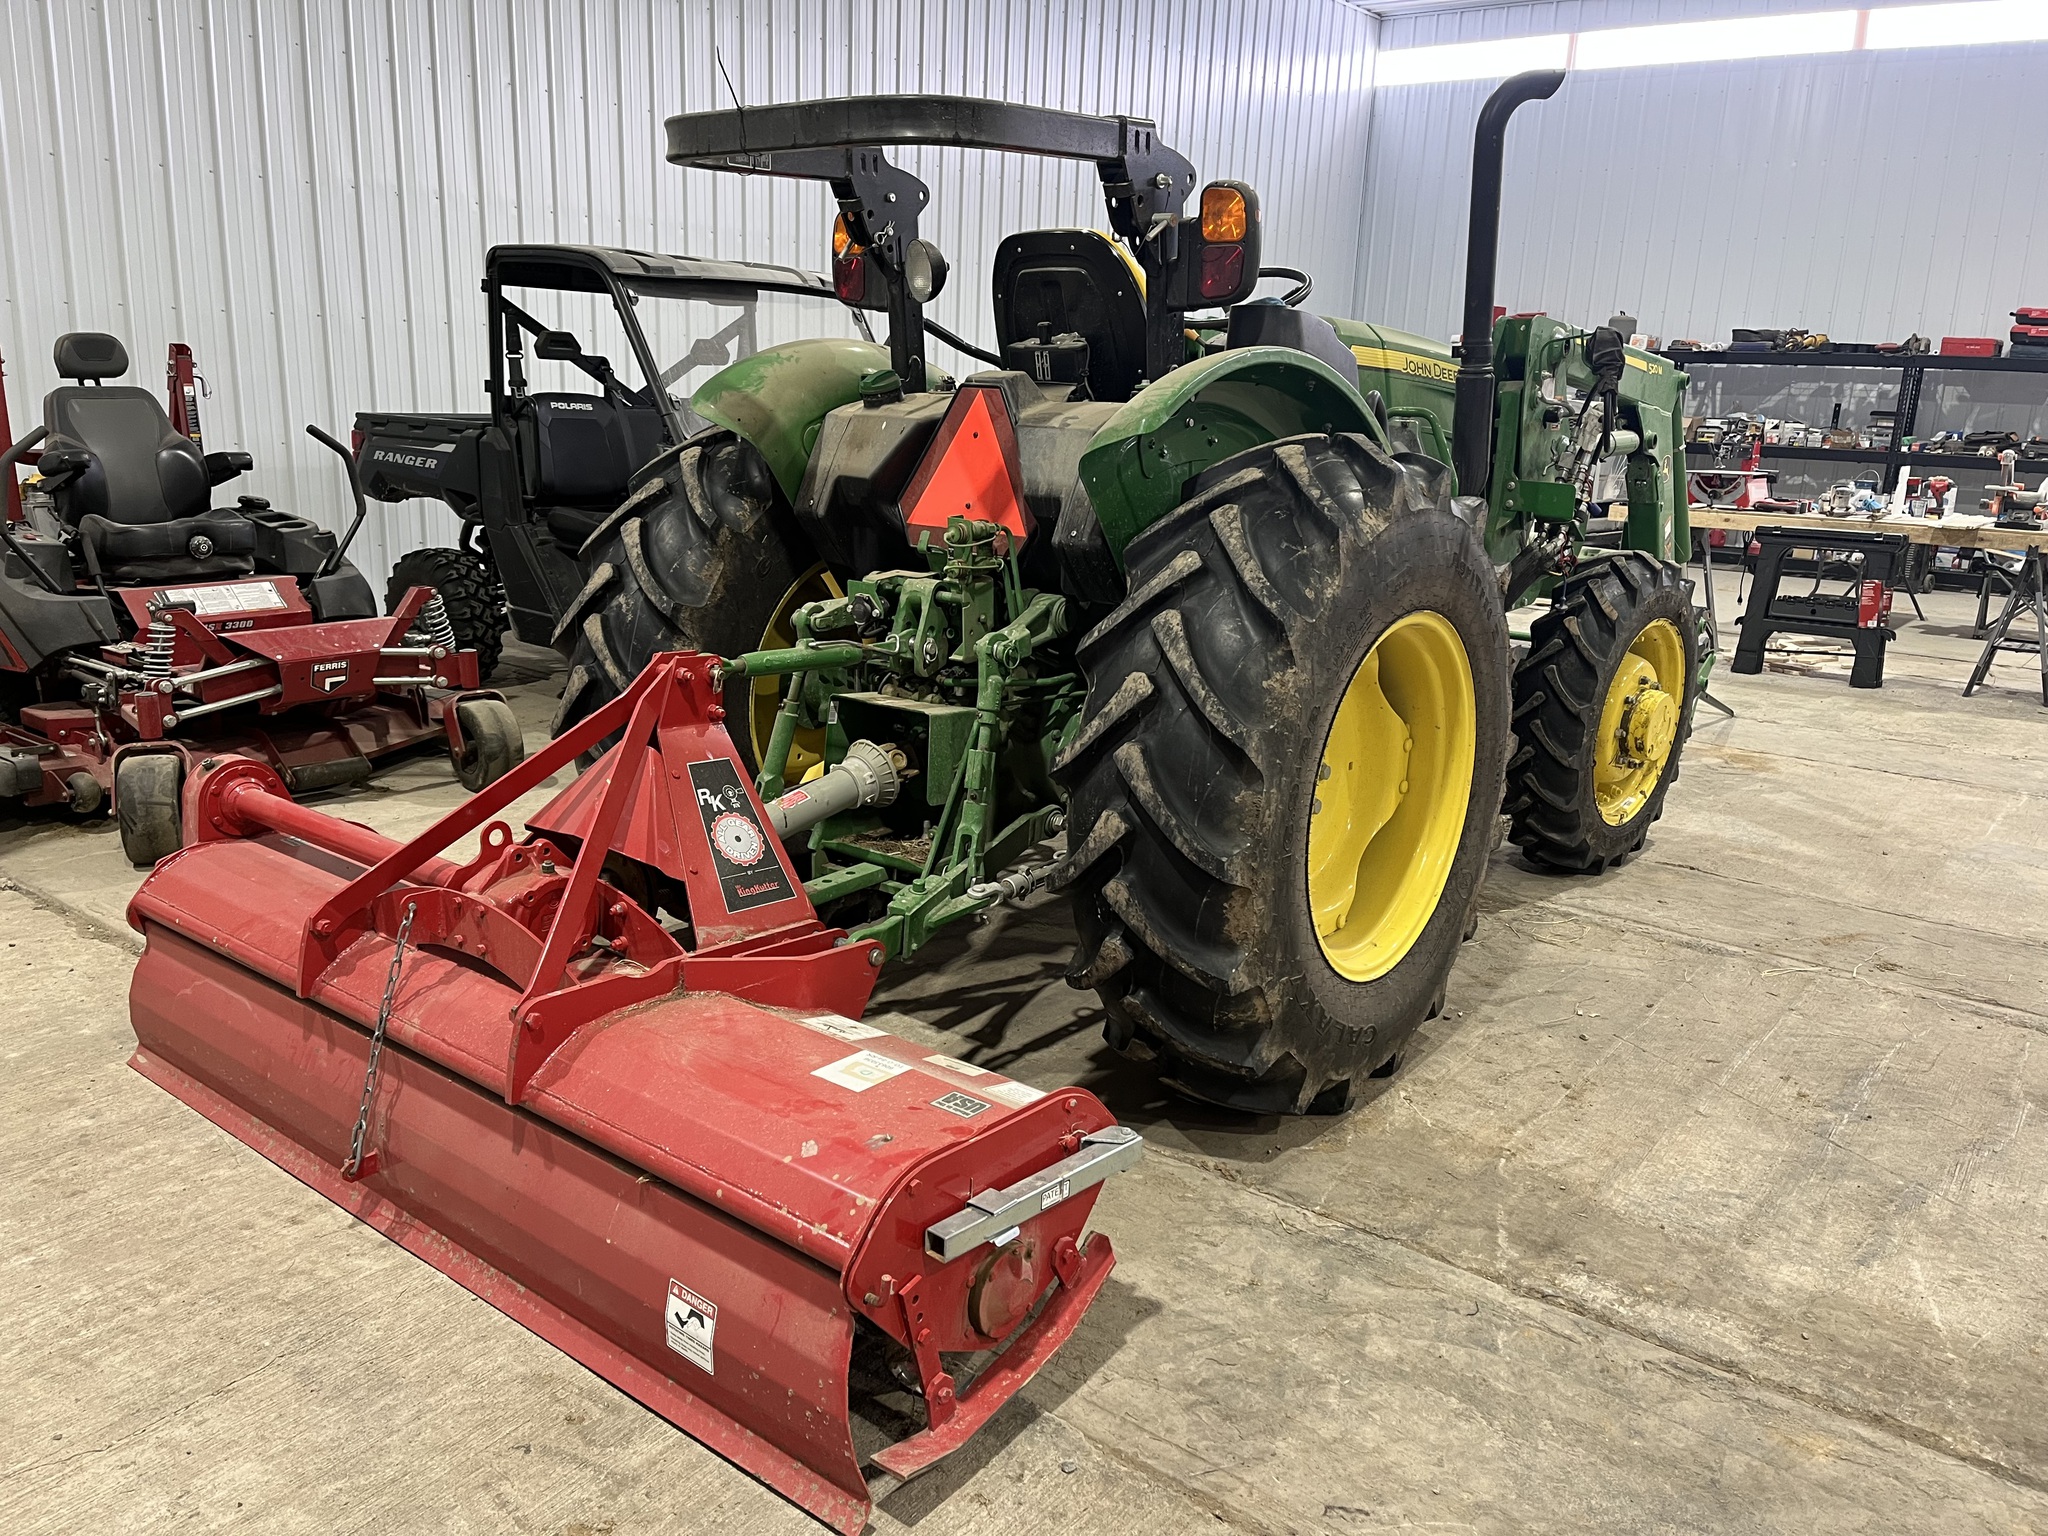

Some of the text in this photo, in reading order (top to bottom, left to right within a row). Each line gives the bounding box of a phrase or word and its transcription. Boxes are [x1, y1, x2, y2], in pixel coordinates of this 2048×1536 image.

[1402, 357, 1432, 377] JOHN
[1648, 363, 1658, 375] 520
[551, 402, 593, 411] POLARIS
[373, 450, 438, 469] RANGER
[225, 619, 254, 630] 3300
[314, 661, 347, 672] FERRIS
[697, 788, 726, 812] RK
[717, 818, 755, 844] ALL GEAR
[725, 841, 758, 860] DRIVEN
[737, 882, 780, 897] KingKutter
[941, 1092, 988, 1114] USA
[1042, 1181, 1070, 1203] PATET
[681, 1289, 714, 1317] DANGER
